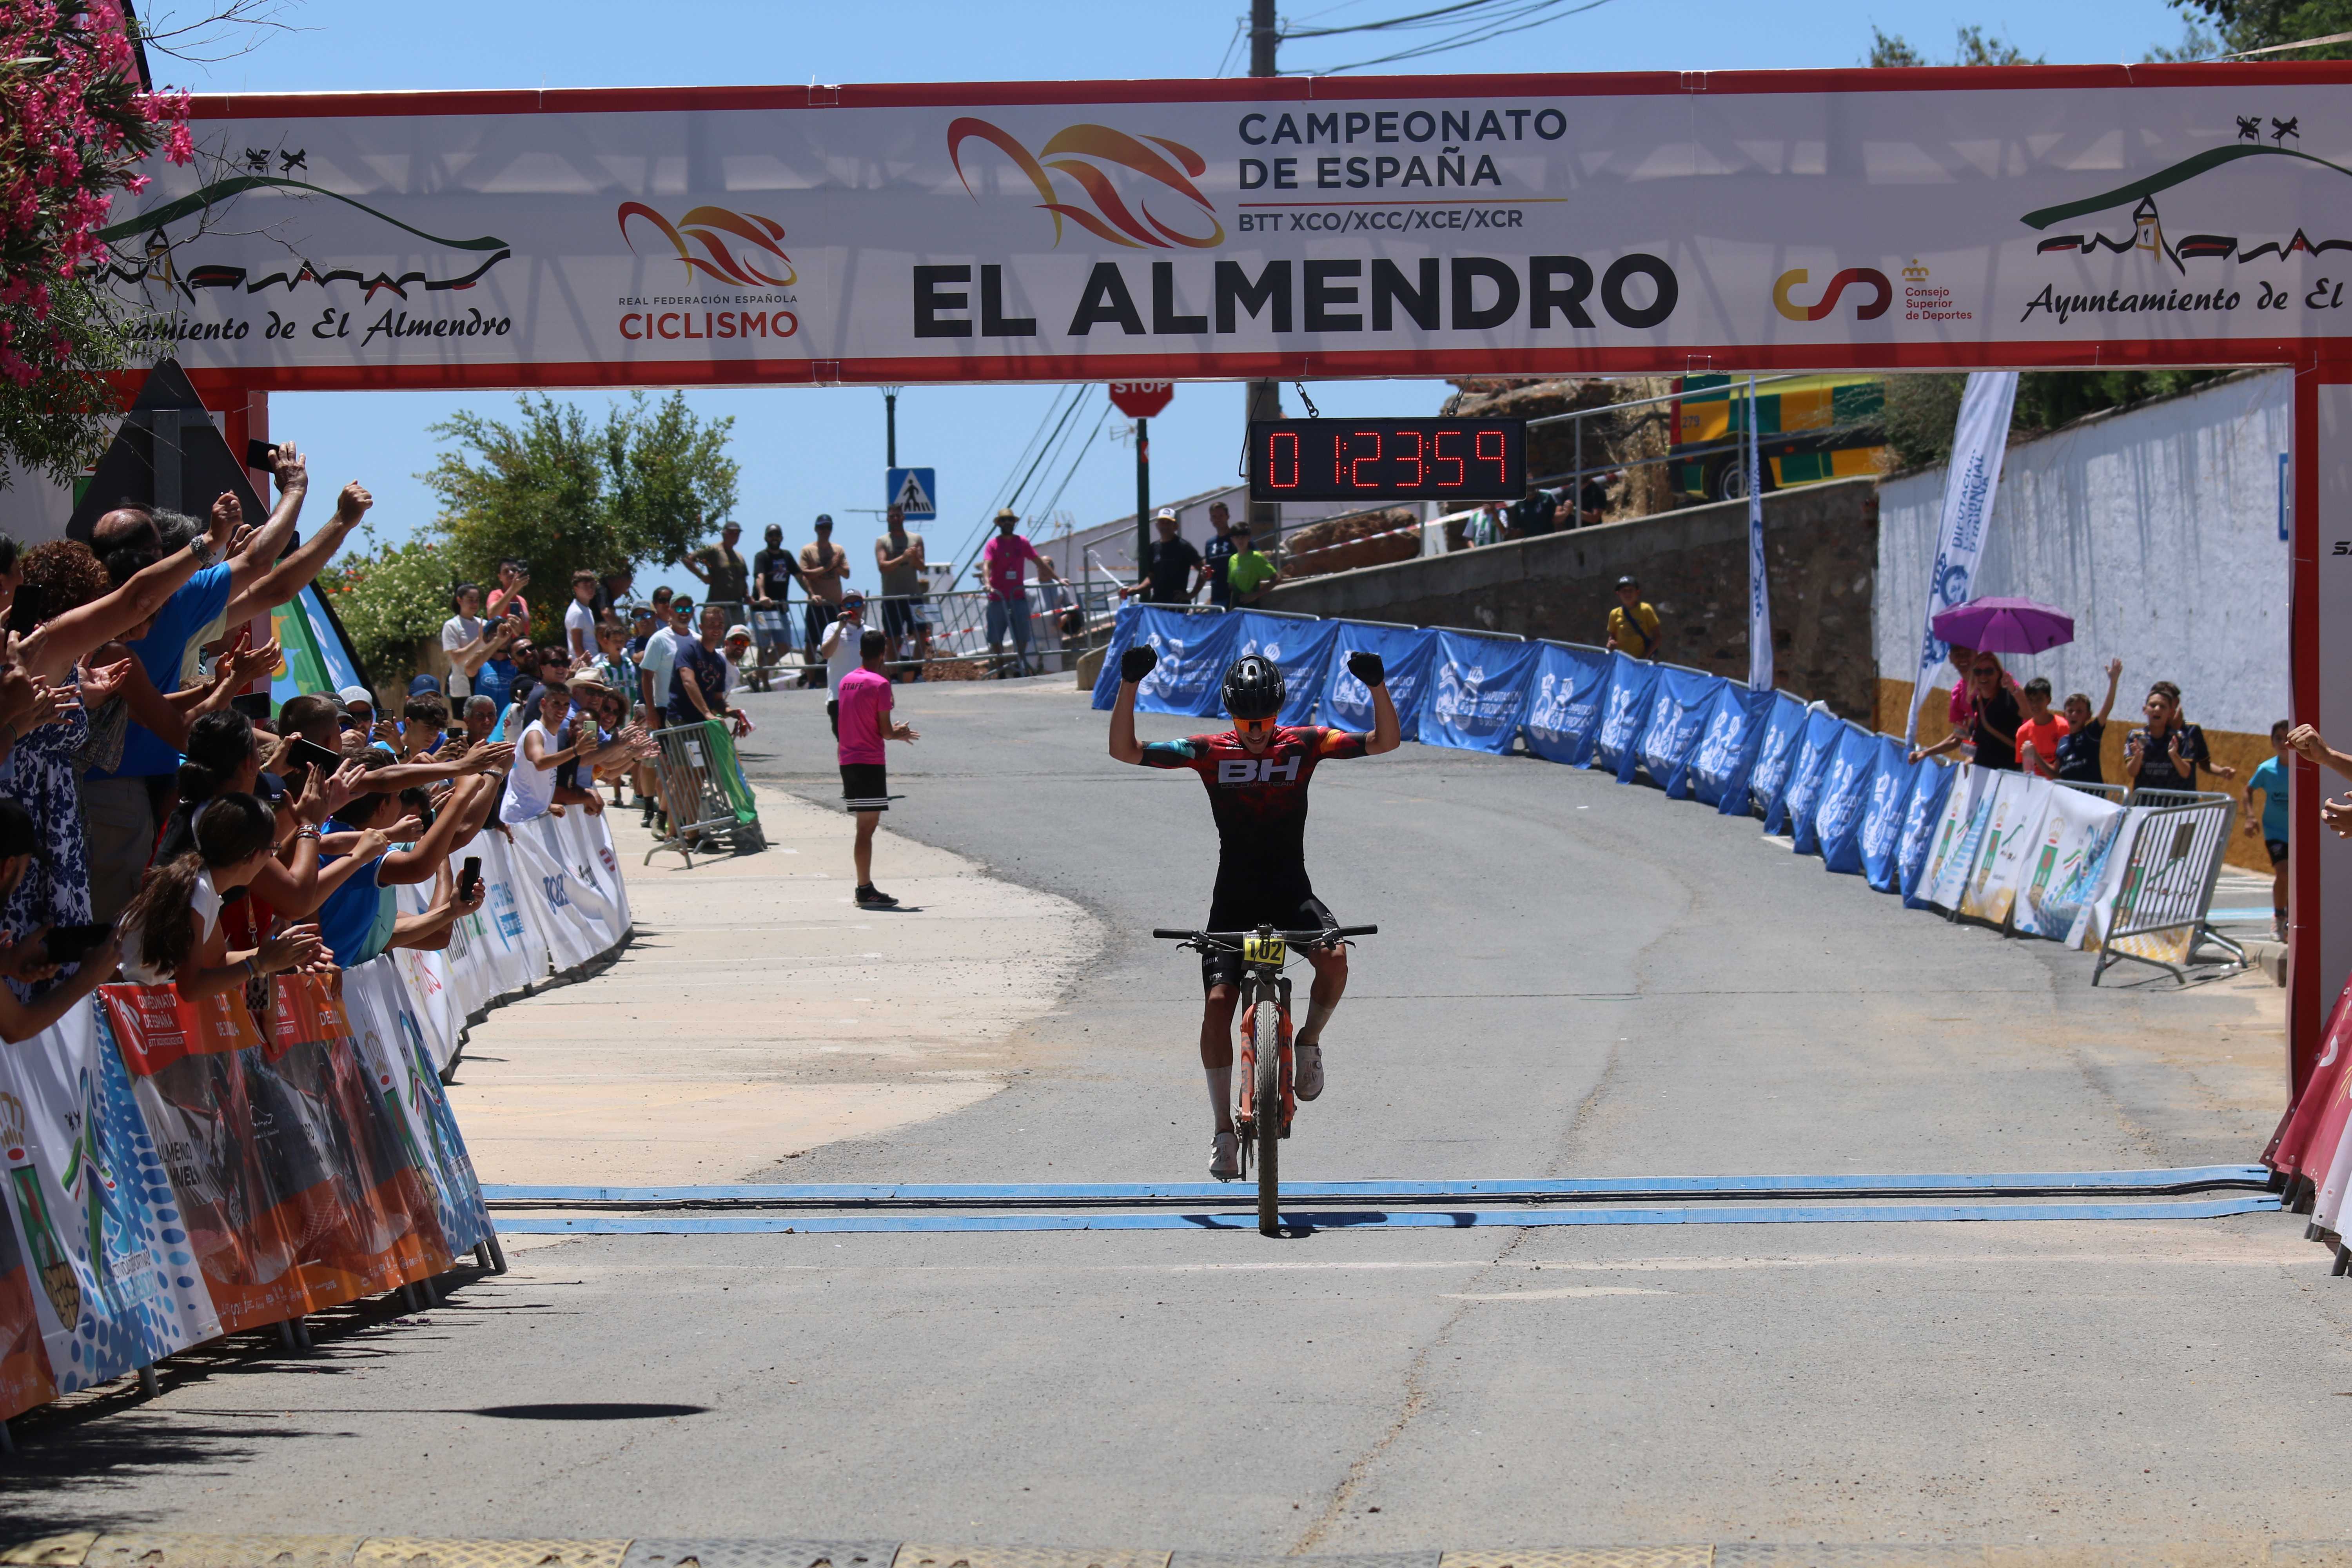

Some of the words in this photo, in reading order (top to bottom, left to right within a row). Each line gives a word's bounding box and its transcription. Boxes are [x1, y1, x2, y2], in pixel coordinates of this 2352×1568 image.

[1239, 108, 1567, 145] CAMPEONATO
[1240, 158, 1298, 190] DE
[1318, 146, 1502, 188] ESPAÑA
[1239, 214, 1283, 232] BTT
[1290, 208, 1523, 233] XCO/XCC/XCE/XCR
[619, 297, 649, 306] REAL
[654, 294, 730, 305] FEDERACIÓN
[735, 293, 798, 304] ESPAÑOLA
[913, 264, 1037, 338] EL
[1067, 253, 1679, 336] ALMENDRO
[1905, 287, 1950, 298] Consejo
[2020, 283, 2240, 325] Ayuntamiento
[2258, 281, 2288, 310] de
[2305, 278, 2343, 309] El
[1906, 298, 1953, 310] Superior
[619, 310, 799, 340] CICLISMO
[1906, 311, 1919, 319] de
[1922, 310, 1972, 322] Deportes
[265, 310, 296, 339] de
[312, 307, 350, 338] El
[361, 307, 511, 348] Almendro
[1114, 383, 1168, 394] STOP
[842, 682, 864, 690] STAFF
[1218, 756, 1301, 783] BH
[1248, 940, 1282, 961] 102
[1203, 956, 1218, 967] GOBIK
[1209, 972, 1223, 981] FOX
